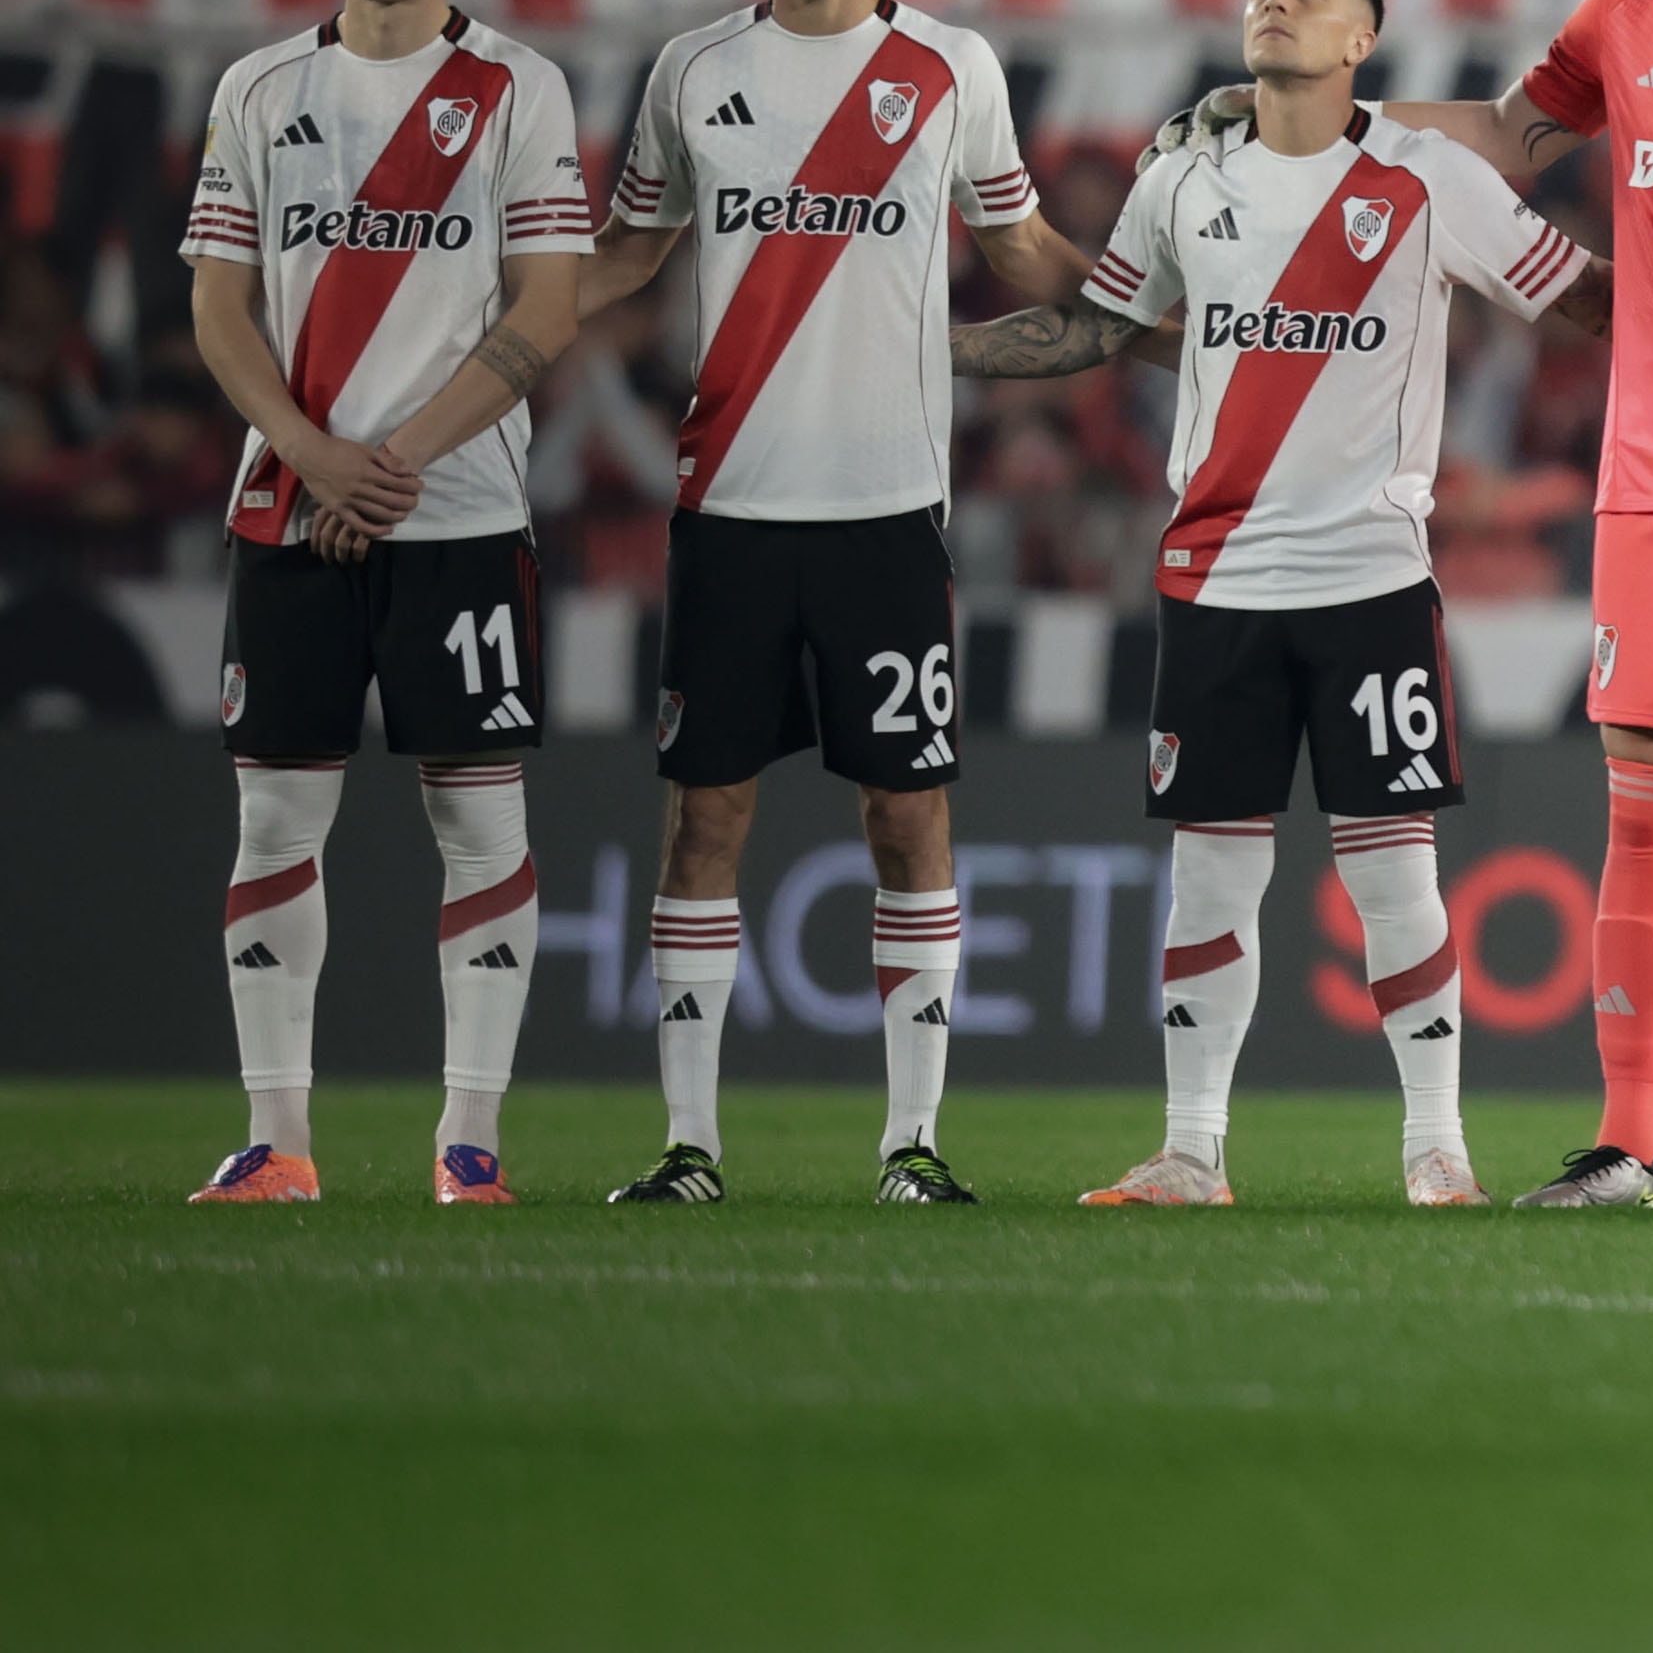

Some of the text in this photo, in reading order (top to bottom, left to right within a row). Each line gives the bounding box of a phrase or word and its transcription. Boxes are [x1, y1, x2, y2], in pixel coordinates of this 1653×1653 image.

[282, 203, 472, 252] Betano
[715, 187, 907, 236] Betano
[1202, 302, 1387, 352] Betano
[444, 604, 520, 694] 11
[865, 642, 955, 734] 26
[1349, 666, 1440, 757] 16
[526, 842, 1174, 1036] HACET
